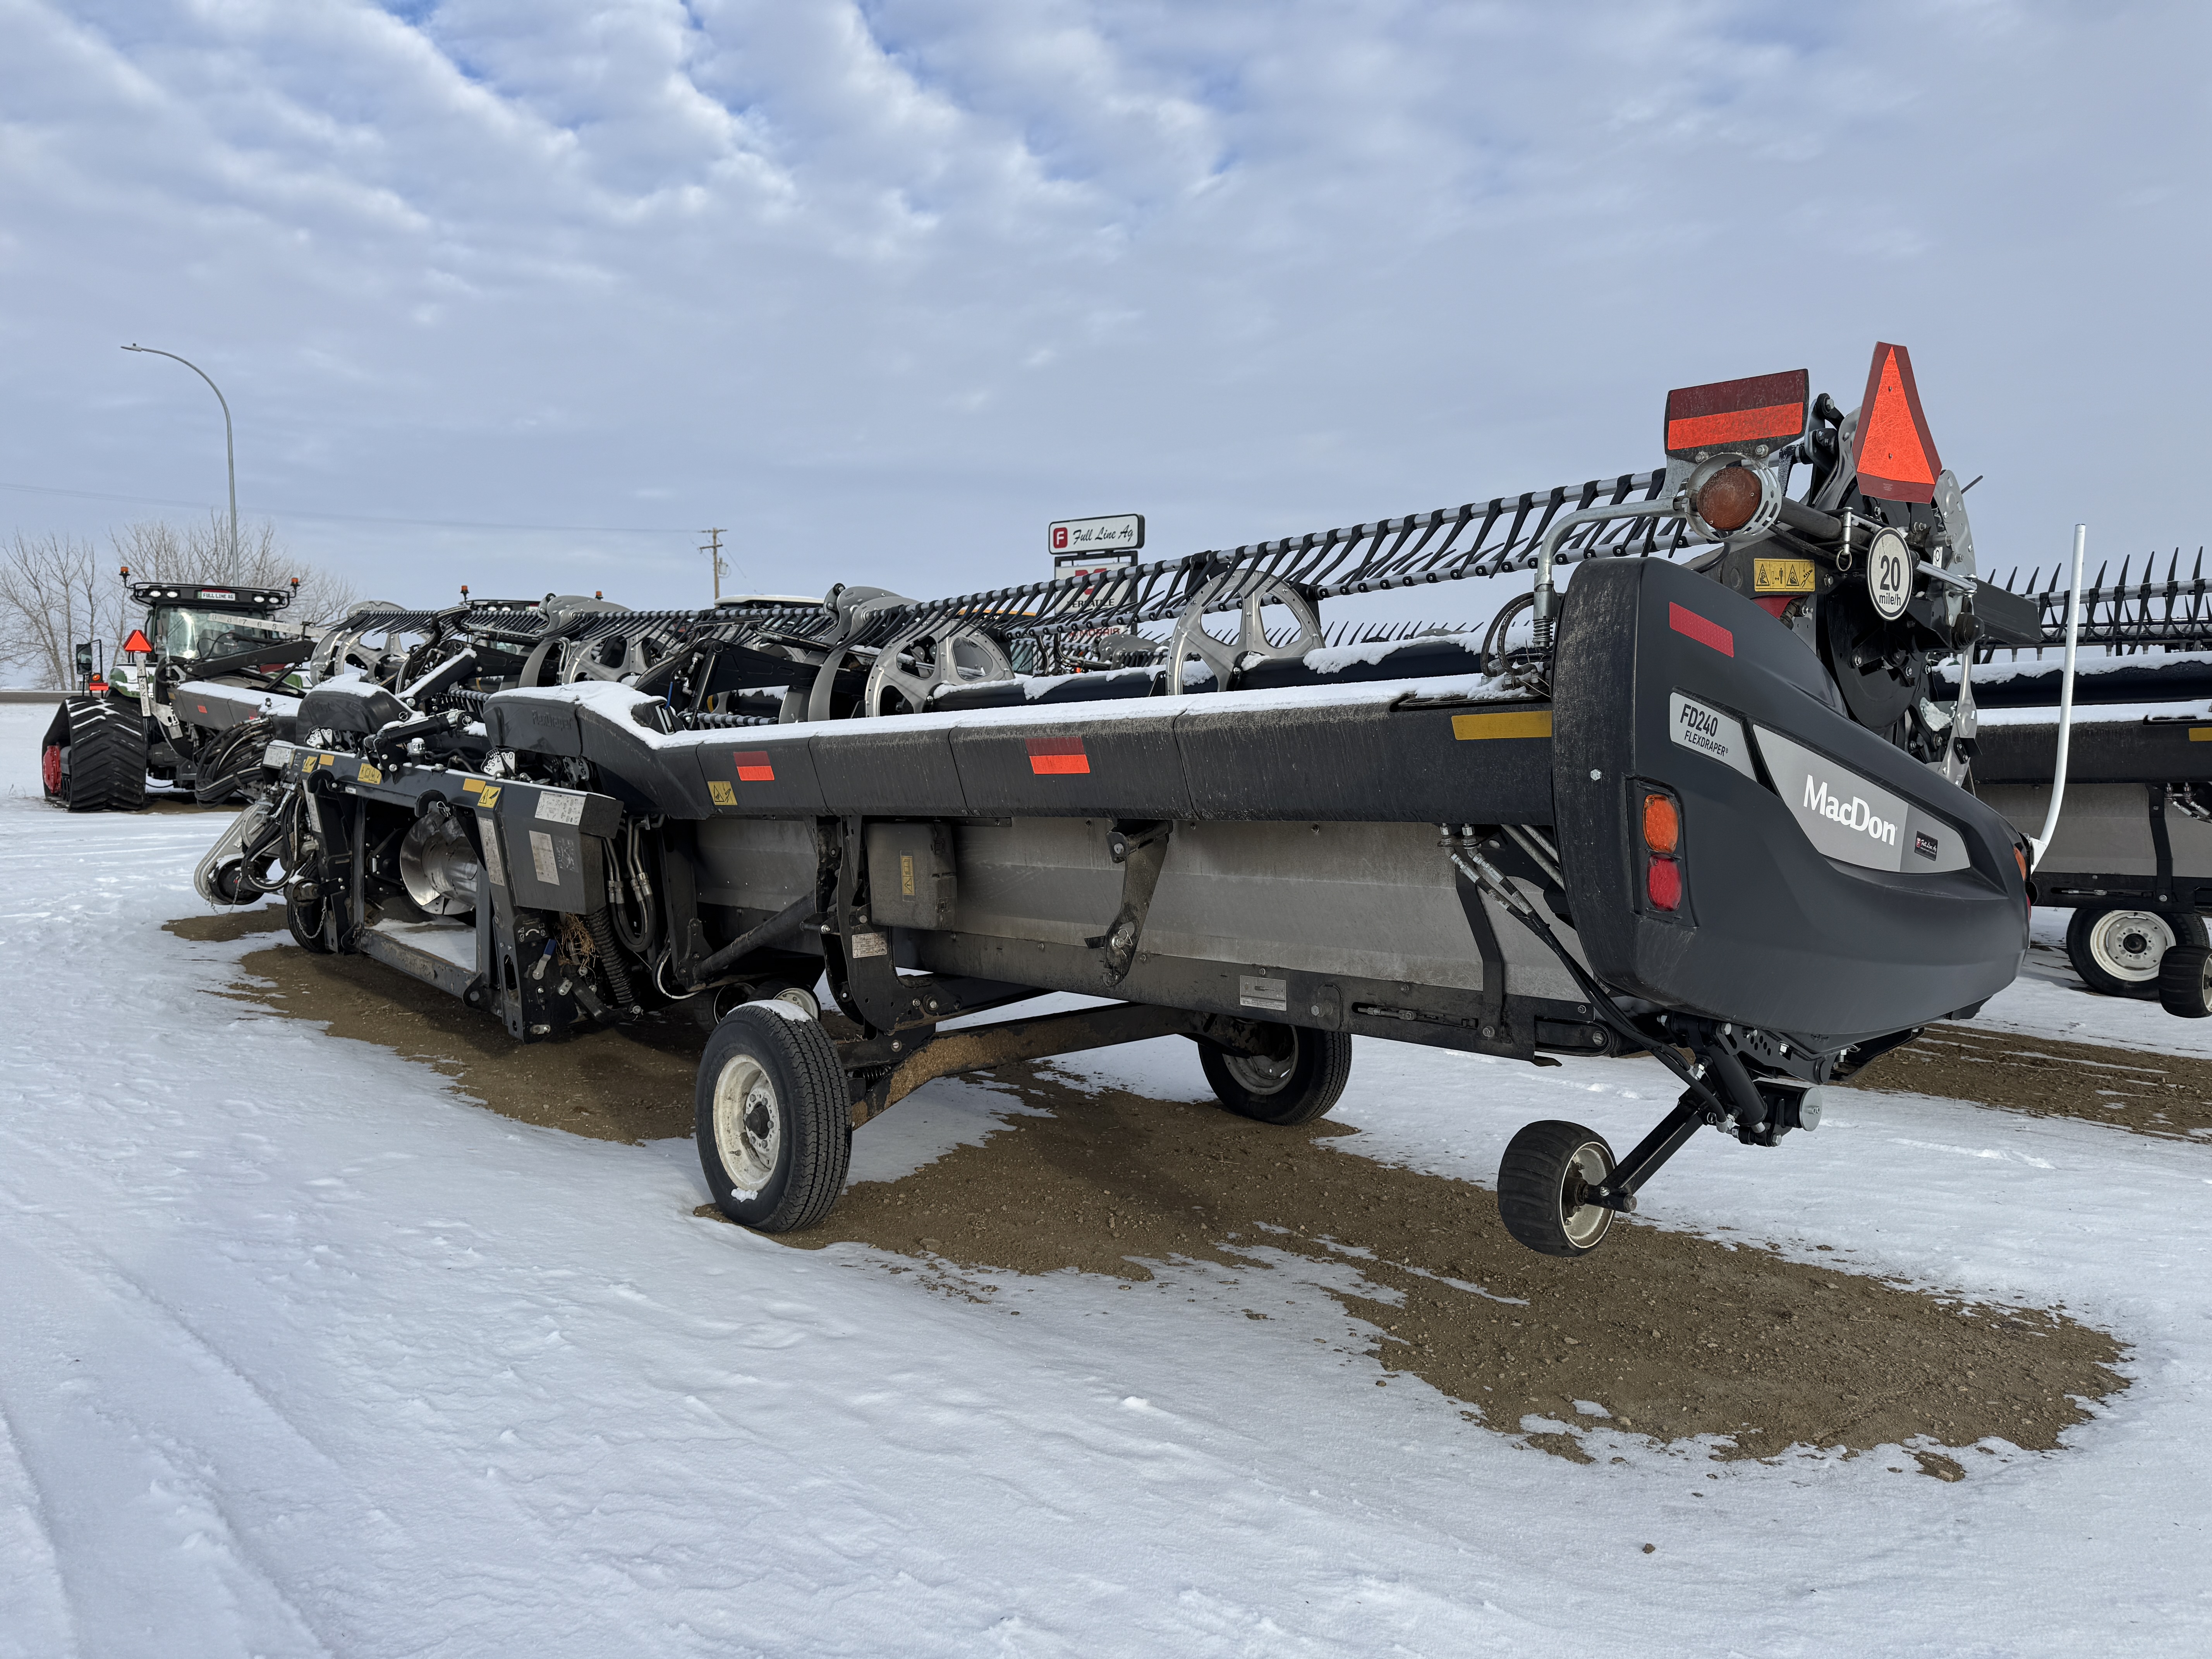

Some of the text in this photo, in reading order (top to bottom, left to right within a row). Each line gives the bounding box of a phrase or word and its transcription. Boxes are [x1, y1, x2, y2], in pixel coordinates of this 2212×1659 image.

[1073, 524, 1133, 544] Full Line Ag
[1880, 555, 1901, 591] 20
[1879, 593, 1901, 606] mile/h
[1680, 704, 1718, 737] FD240
[1803, 775, 1896, 846] MacDon
